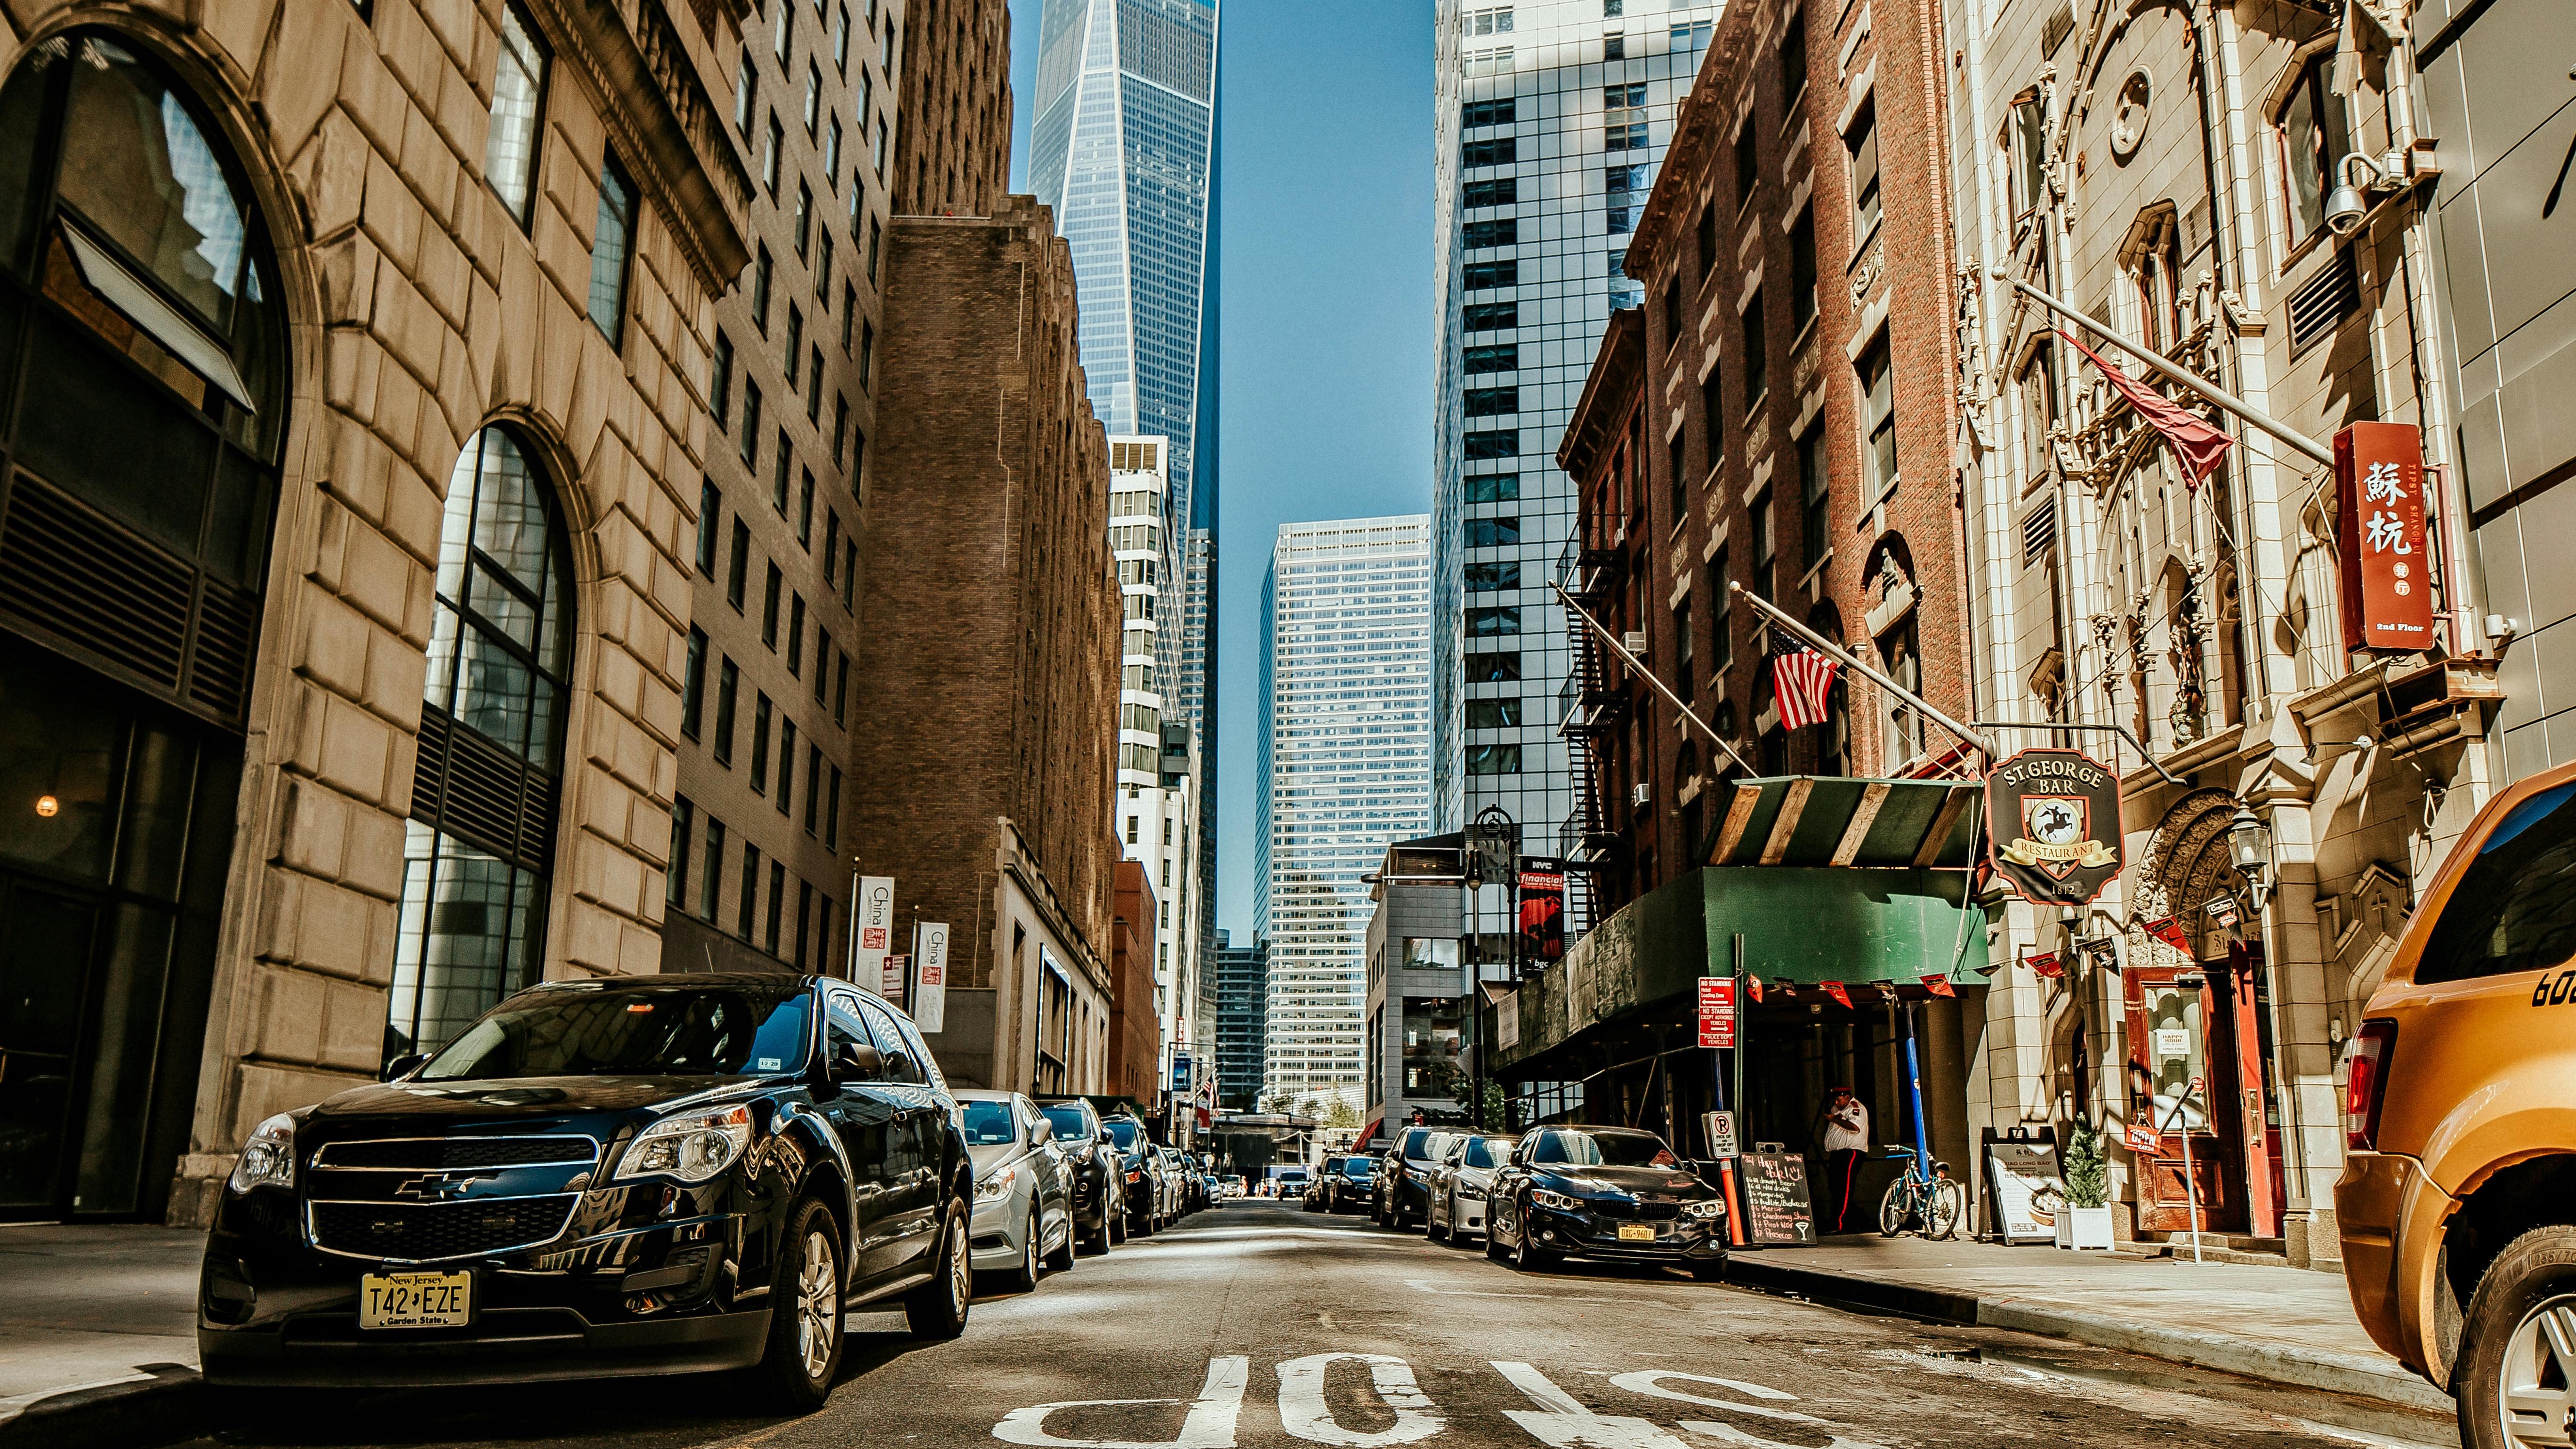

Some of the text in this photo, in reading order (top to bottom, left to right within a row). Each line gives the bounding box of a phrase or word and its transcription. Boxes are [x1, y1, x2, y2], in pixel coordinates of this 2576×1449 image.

[2363, 461, 2412, 555] 蘇杭
[2407, 464, 2422, 555] TIPSY SHANGHAI
[2397, 624, 2424, 632] Floor
[2039, 779, 2076, 794] BAR
[2021, 842, 2094, 858] RESTAURANT
[1521, 874, 1563, 884] financial
[2052, 886, 2075, 894] 1812
[872, 887, 889, 925] China
[930, 931, 944, 964] China
[1535, 959, 1548, 968] bgc
[2131, 1132, 2156, 1146] OPEN
[1636, 1230, 1651, 1239] 9607
[389, 1275, 443, 1286] New Jersey
[423, 1286, 462, 1313] EZE
